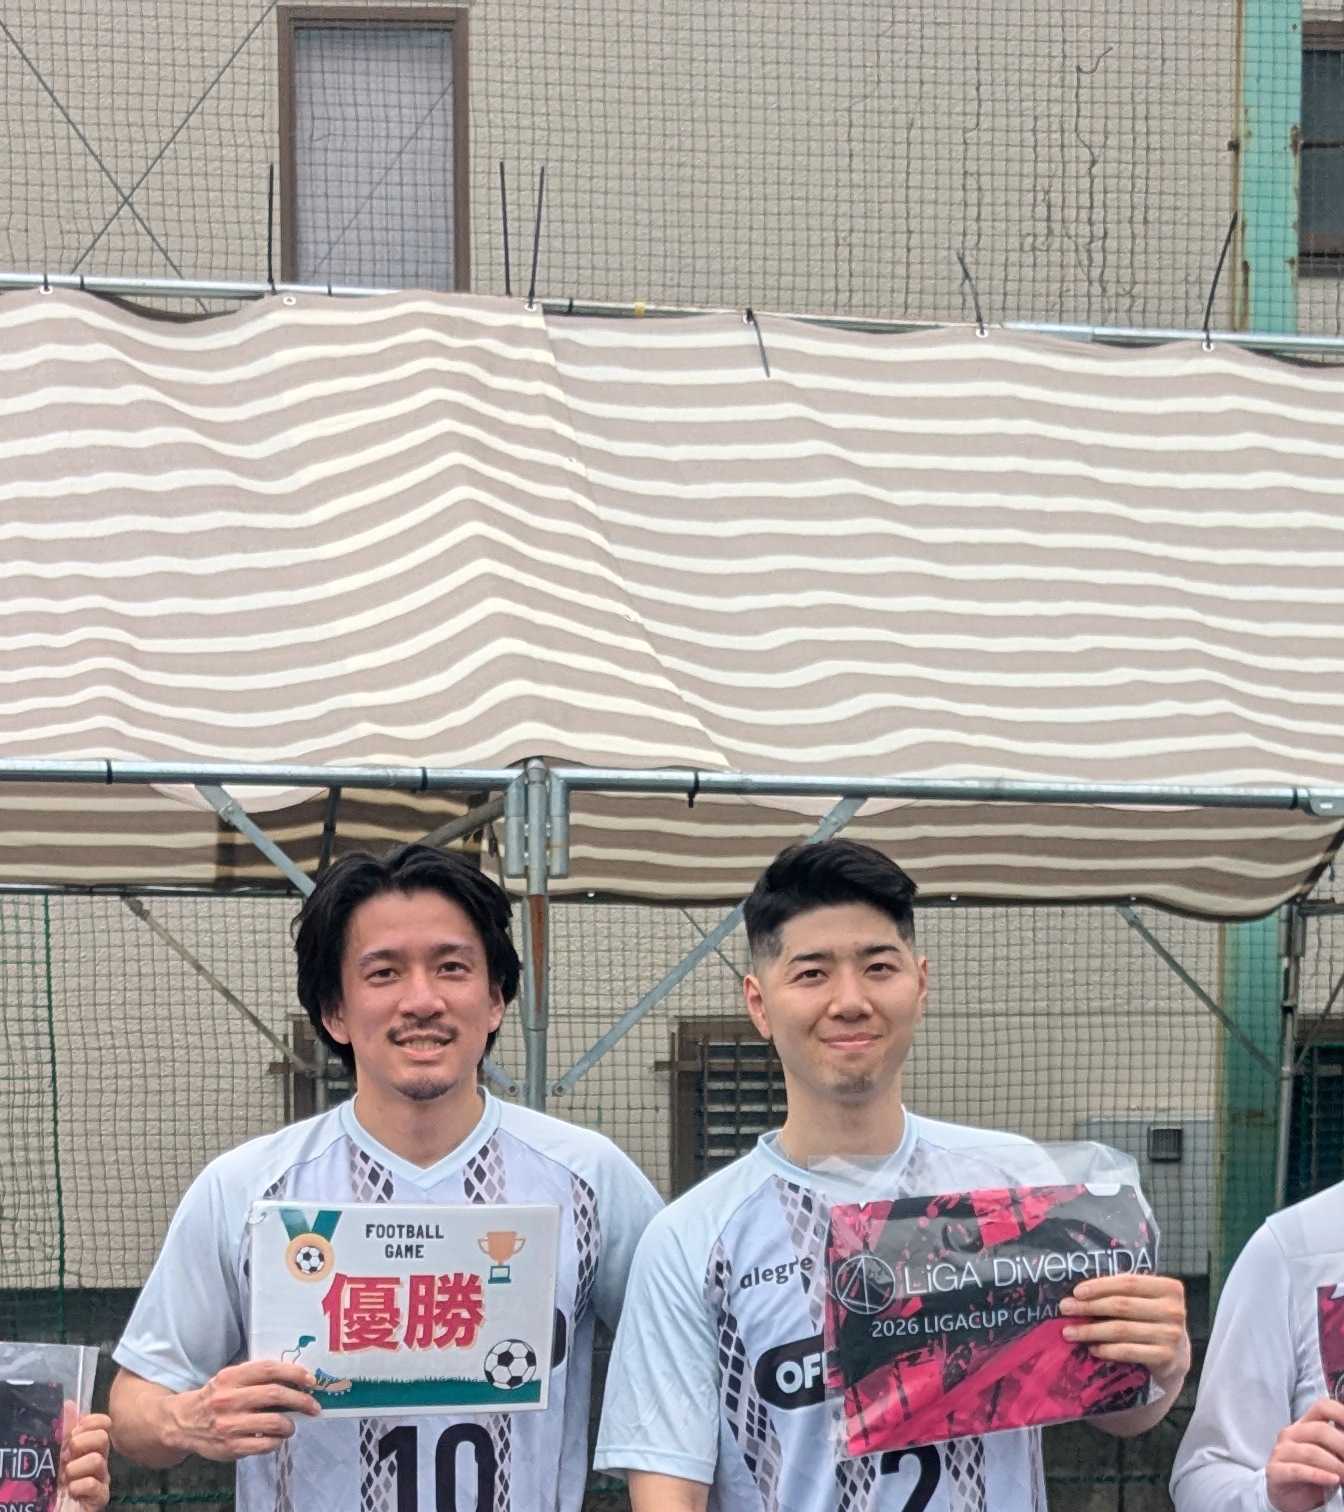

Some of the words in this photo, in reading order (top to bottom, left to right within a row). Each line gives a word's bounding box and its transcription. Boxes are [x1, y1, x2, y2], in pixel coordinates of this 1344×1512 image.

[365, 1223, 445, 1240] FOOTBALL
[384, 1244, 425, 1259] GAME
[739, 1256, 813, 1289] alegre
[321, 1271, 485, 1353] 優勝
[871, 1318, 919, 1338] 2026
[924, 1310, 1009, 1334] LIGACUP
